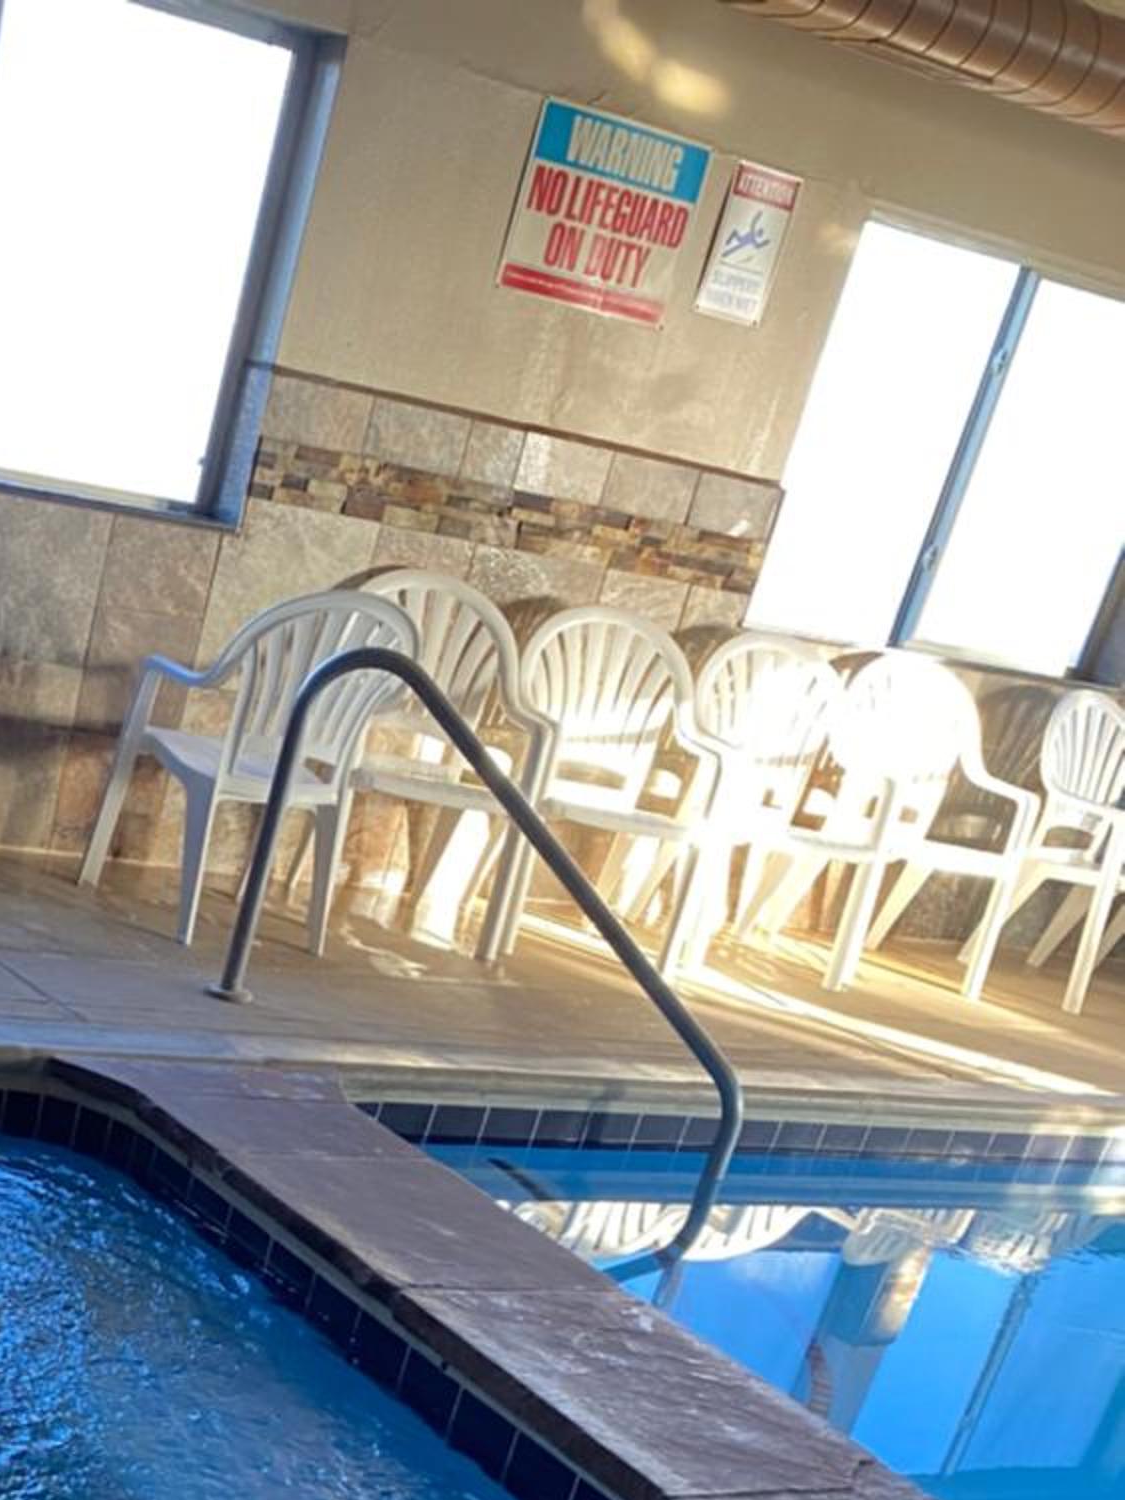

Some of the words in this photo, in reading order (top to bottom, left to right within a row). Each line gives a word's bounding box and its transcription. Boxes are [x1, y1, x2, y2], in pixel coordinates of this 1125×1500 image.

[566, 115, 683, 191] WARNING
[527, 165, 569, 216] NO
[565, 176, 689, 248] LIFEGUARD
[544, 222, 586, 272] ON
[583, 232, 651, 288] DUTY
